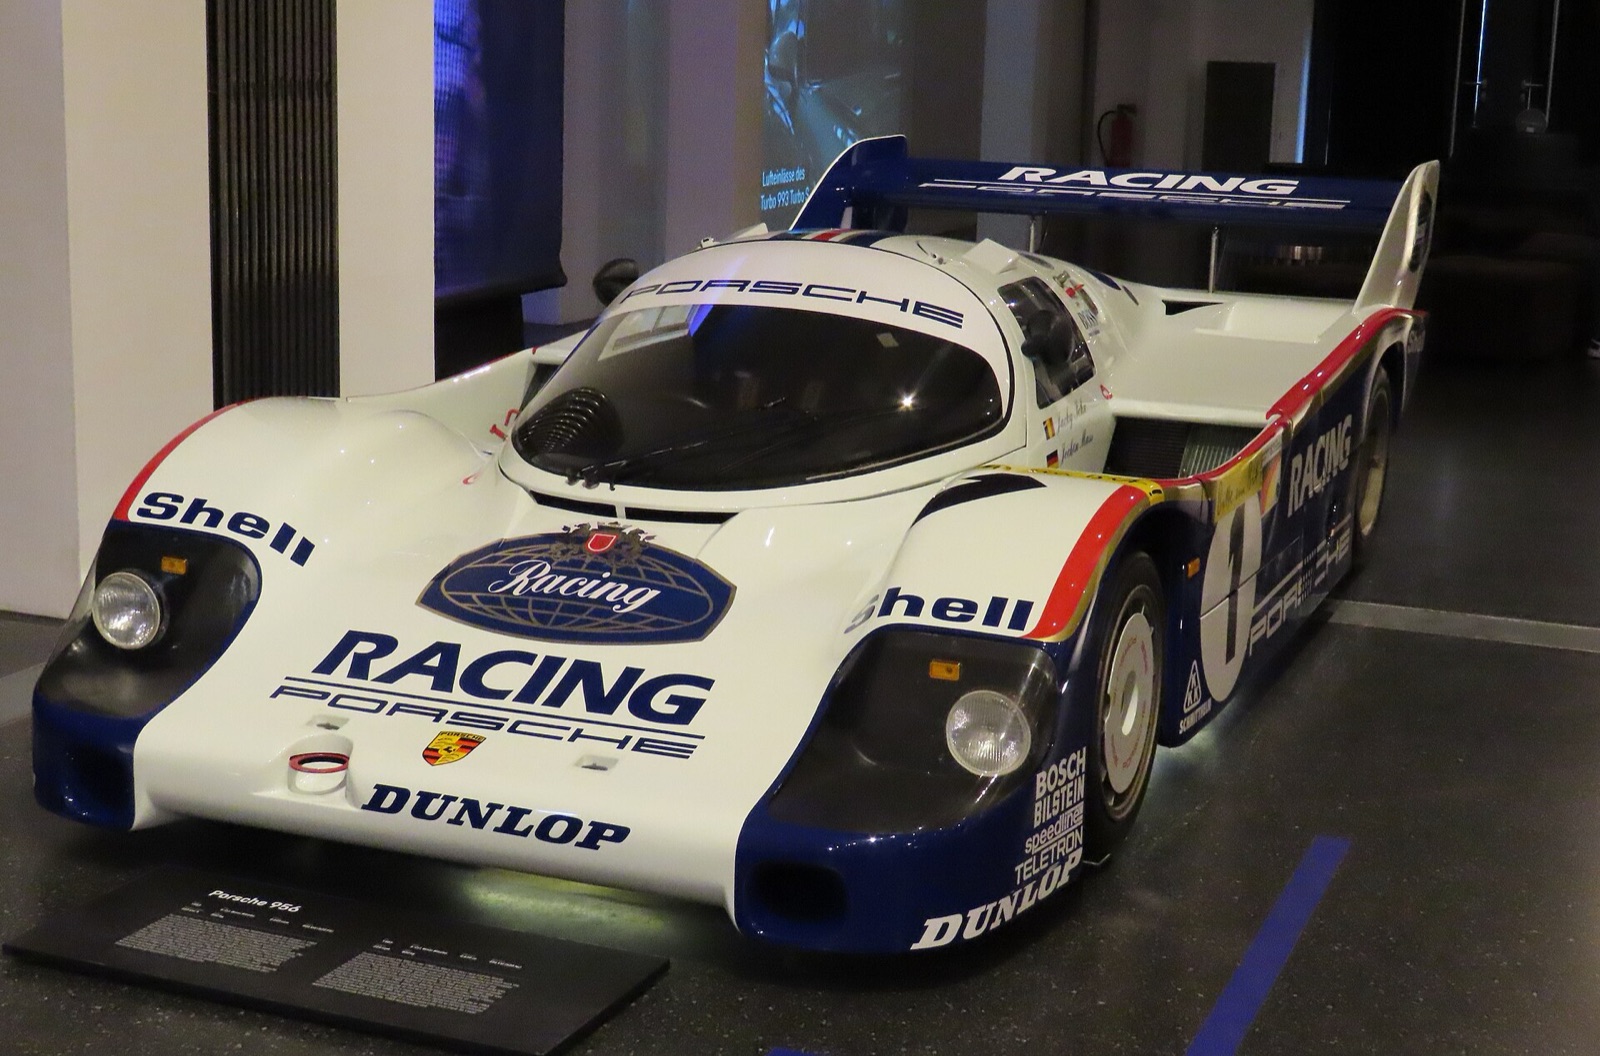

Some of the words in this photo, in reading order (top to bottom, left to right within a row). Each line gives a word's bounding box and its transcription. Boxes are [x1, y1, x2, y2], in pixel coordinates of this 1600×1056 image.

[761, 194, 776, 211] Turbo
[777, 189, 789, 207] 993
[790, 189, 804, 205] Turbo
[762, 168, 795, 187] Lufteinlässe
[795, 166, 805, 180] des
[997, 166, 1300, 195] RACING
[620, 280, 964, 329] PORSCHE
[1287, 414, 1352, 518] RACING
[136, 492, 316, 567] Shell
[487, 559, 662, 613] Racing
[844, 587, 1034, 634] Shell
[311, 630, 716, 725] RACING
[269, 684, 699, 760] PORSCHE
[440, 731, 485, 741] PORSCHE
[1036, 746, 1087, 800] BOSCH
[361, 783, 631, 851] DUNLOP
[1033, 773, 1085, 828] BILSTEIN
[1014, 826, 1083, 885] TELETRON
[1025, 806, 1082, 854] speedline
[208, 889, 268, 907] Porsche
[269, 900, 302, 913] 956
[910, 847, 1083, 950] DUNLOP
